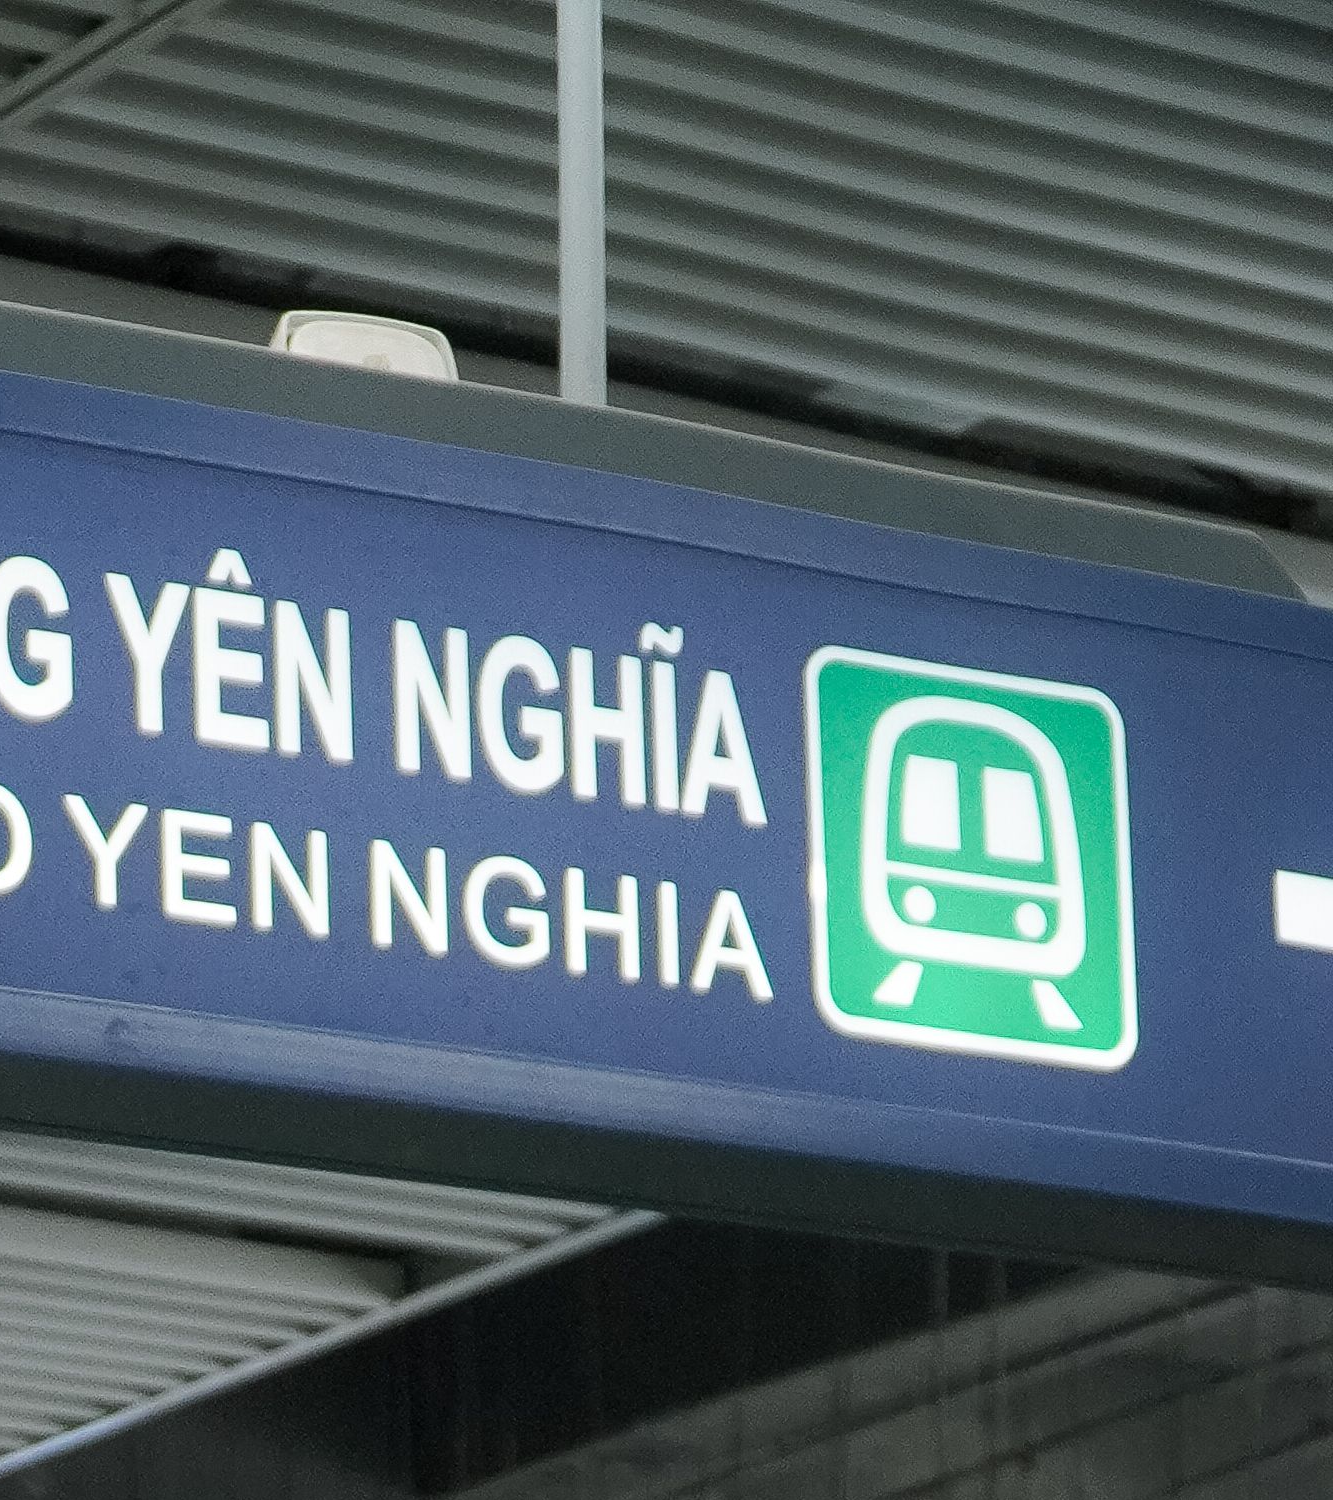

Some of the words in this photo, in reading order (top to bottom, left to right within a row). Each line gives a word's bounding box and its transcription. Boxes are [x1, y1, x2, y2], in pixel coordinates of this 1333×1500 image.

[106, 549, 353, 762] YÊN
[394, 619, 767, 826] NGHĨA
[65, 795, 329, 937] YEN
[371, 840, 773, 1001] NGHIA
